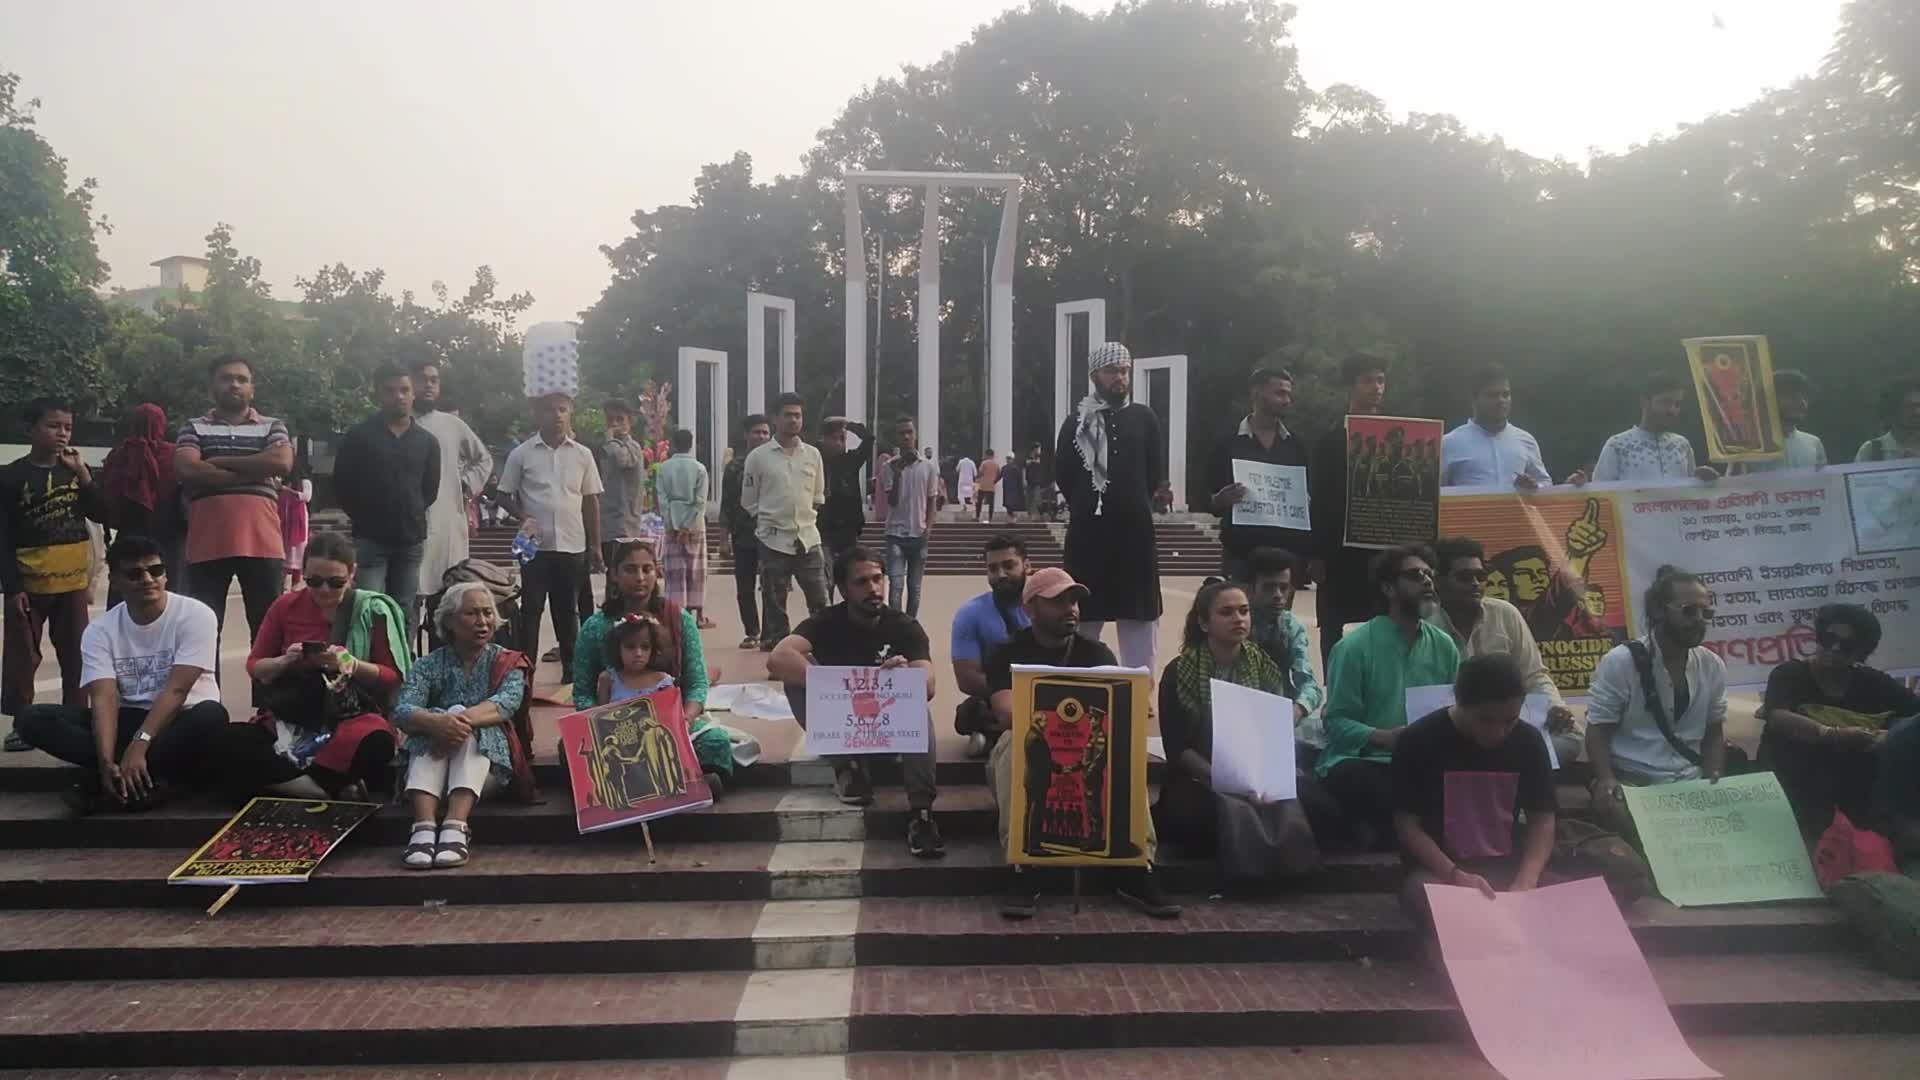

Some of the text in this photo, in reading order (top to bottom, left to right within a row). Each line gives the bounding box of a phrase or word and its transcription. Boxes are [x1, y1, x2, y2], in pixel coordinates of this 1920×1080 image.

[1767, 582, 1829, 601] মানবতার
[1754, 608, 1784, 625] এবং
[1538, 639, 1613, 655] NOCIDE
[189, 860, 315, 870] NOT DISPOSABLE
